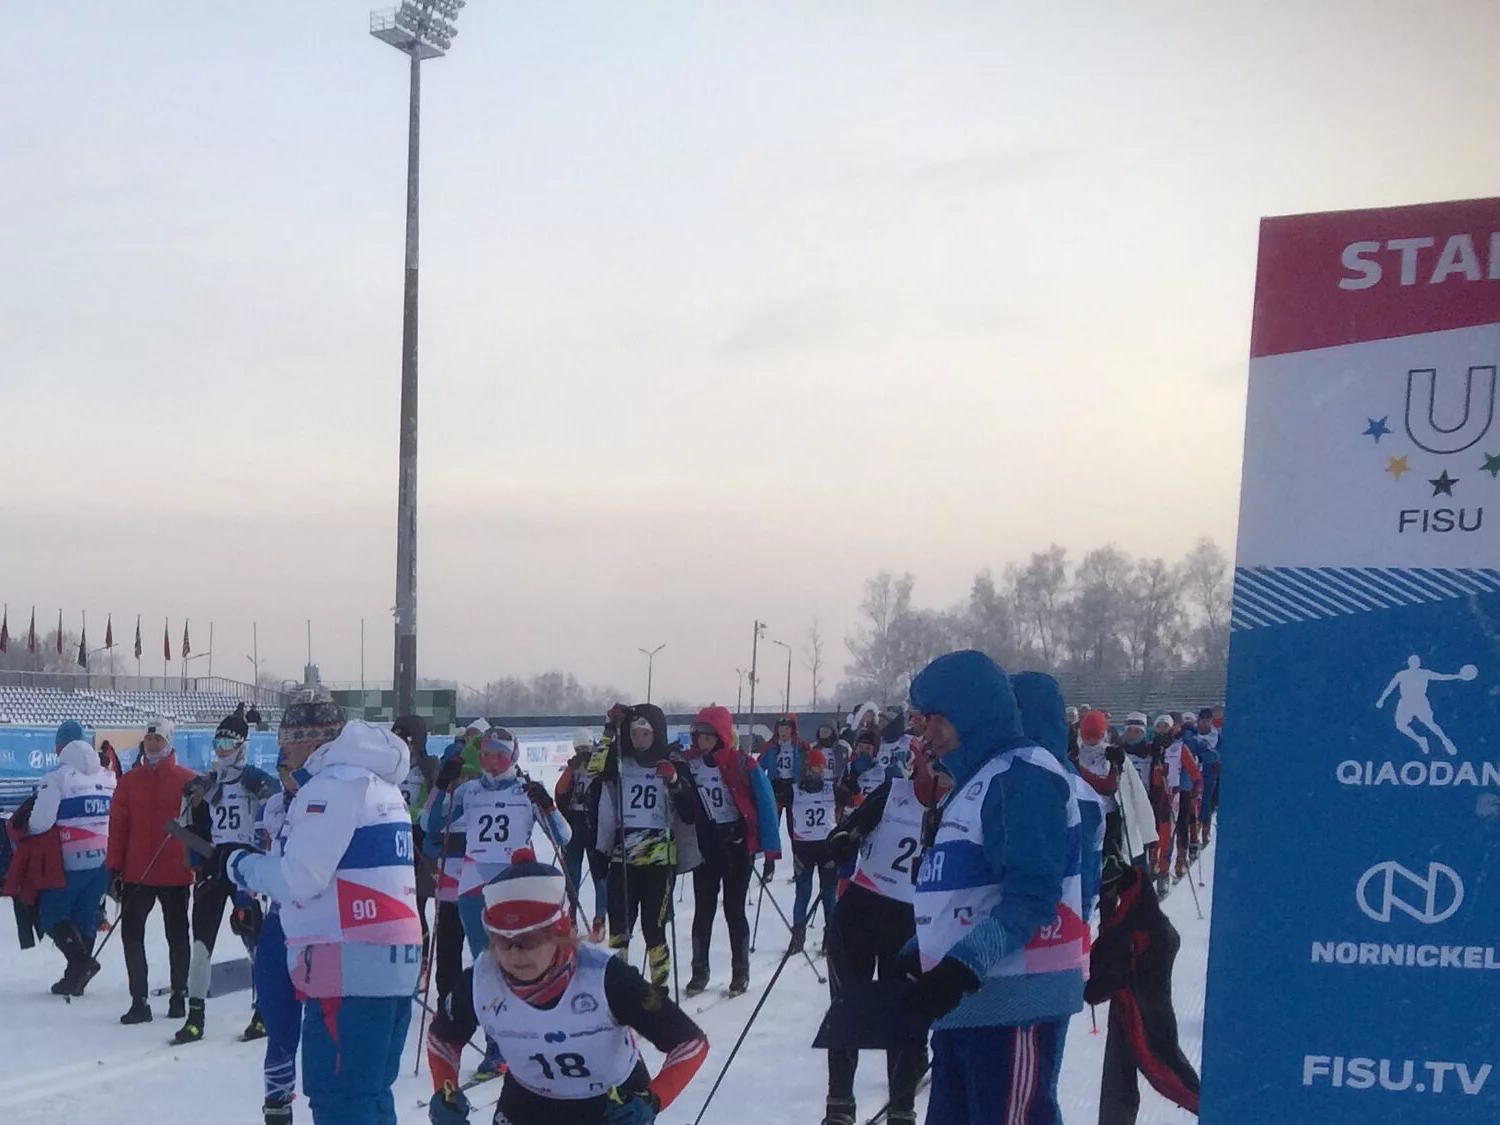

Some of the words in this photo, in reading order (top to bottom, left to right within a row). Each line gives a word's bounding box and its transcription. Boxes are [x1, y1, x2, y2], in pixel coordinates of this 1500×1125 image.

[1338, 232, 1500, 291] STA
[1399, 508, 1484, 534] FISU
[777, 757, 793, 769] 43
[1336, 759, 1500, 787] QIAODAN
[630, 784, 658, 809] 26
[215, 805, 241, 830] 25
[478, 814, 510, 843] 23
[805, 807, 826, 828] 32
[352, 899, 377, 921] 90
[1310, 940, 1500, 970] NORNICKEL
[528, 1052, 591, 1080] 18
[1302, 1054, 1493, 1096] FISU.TV
